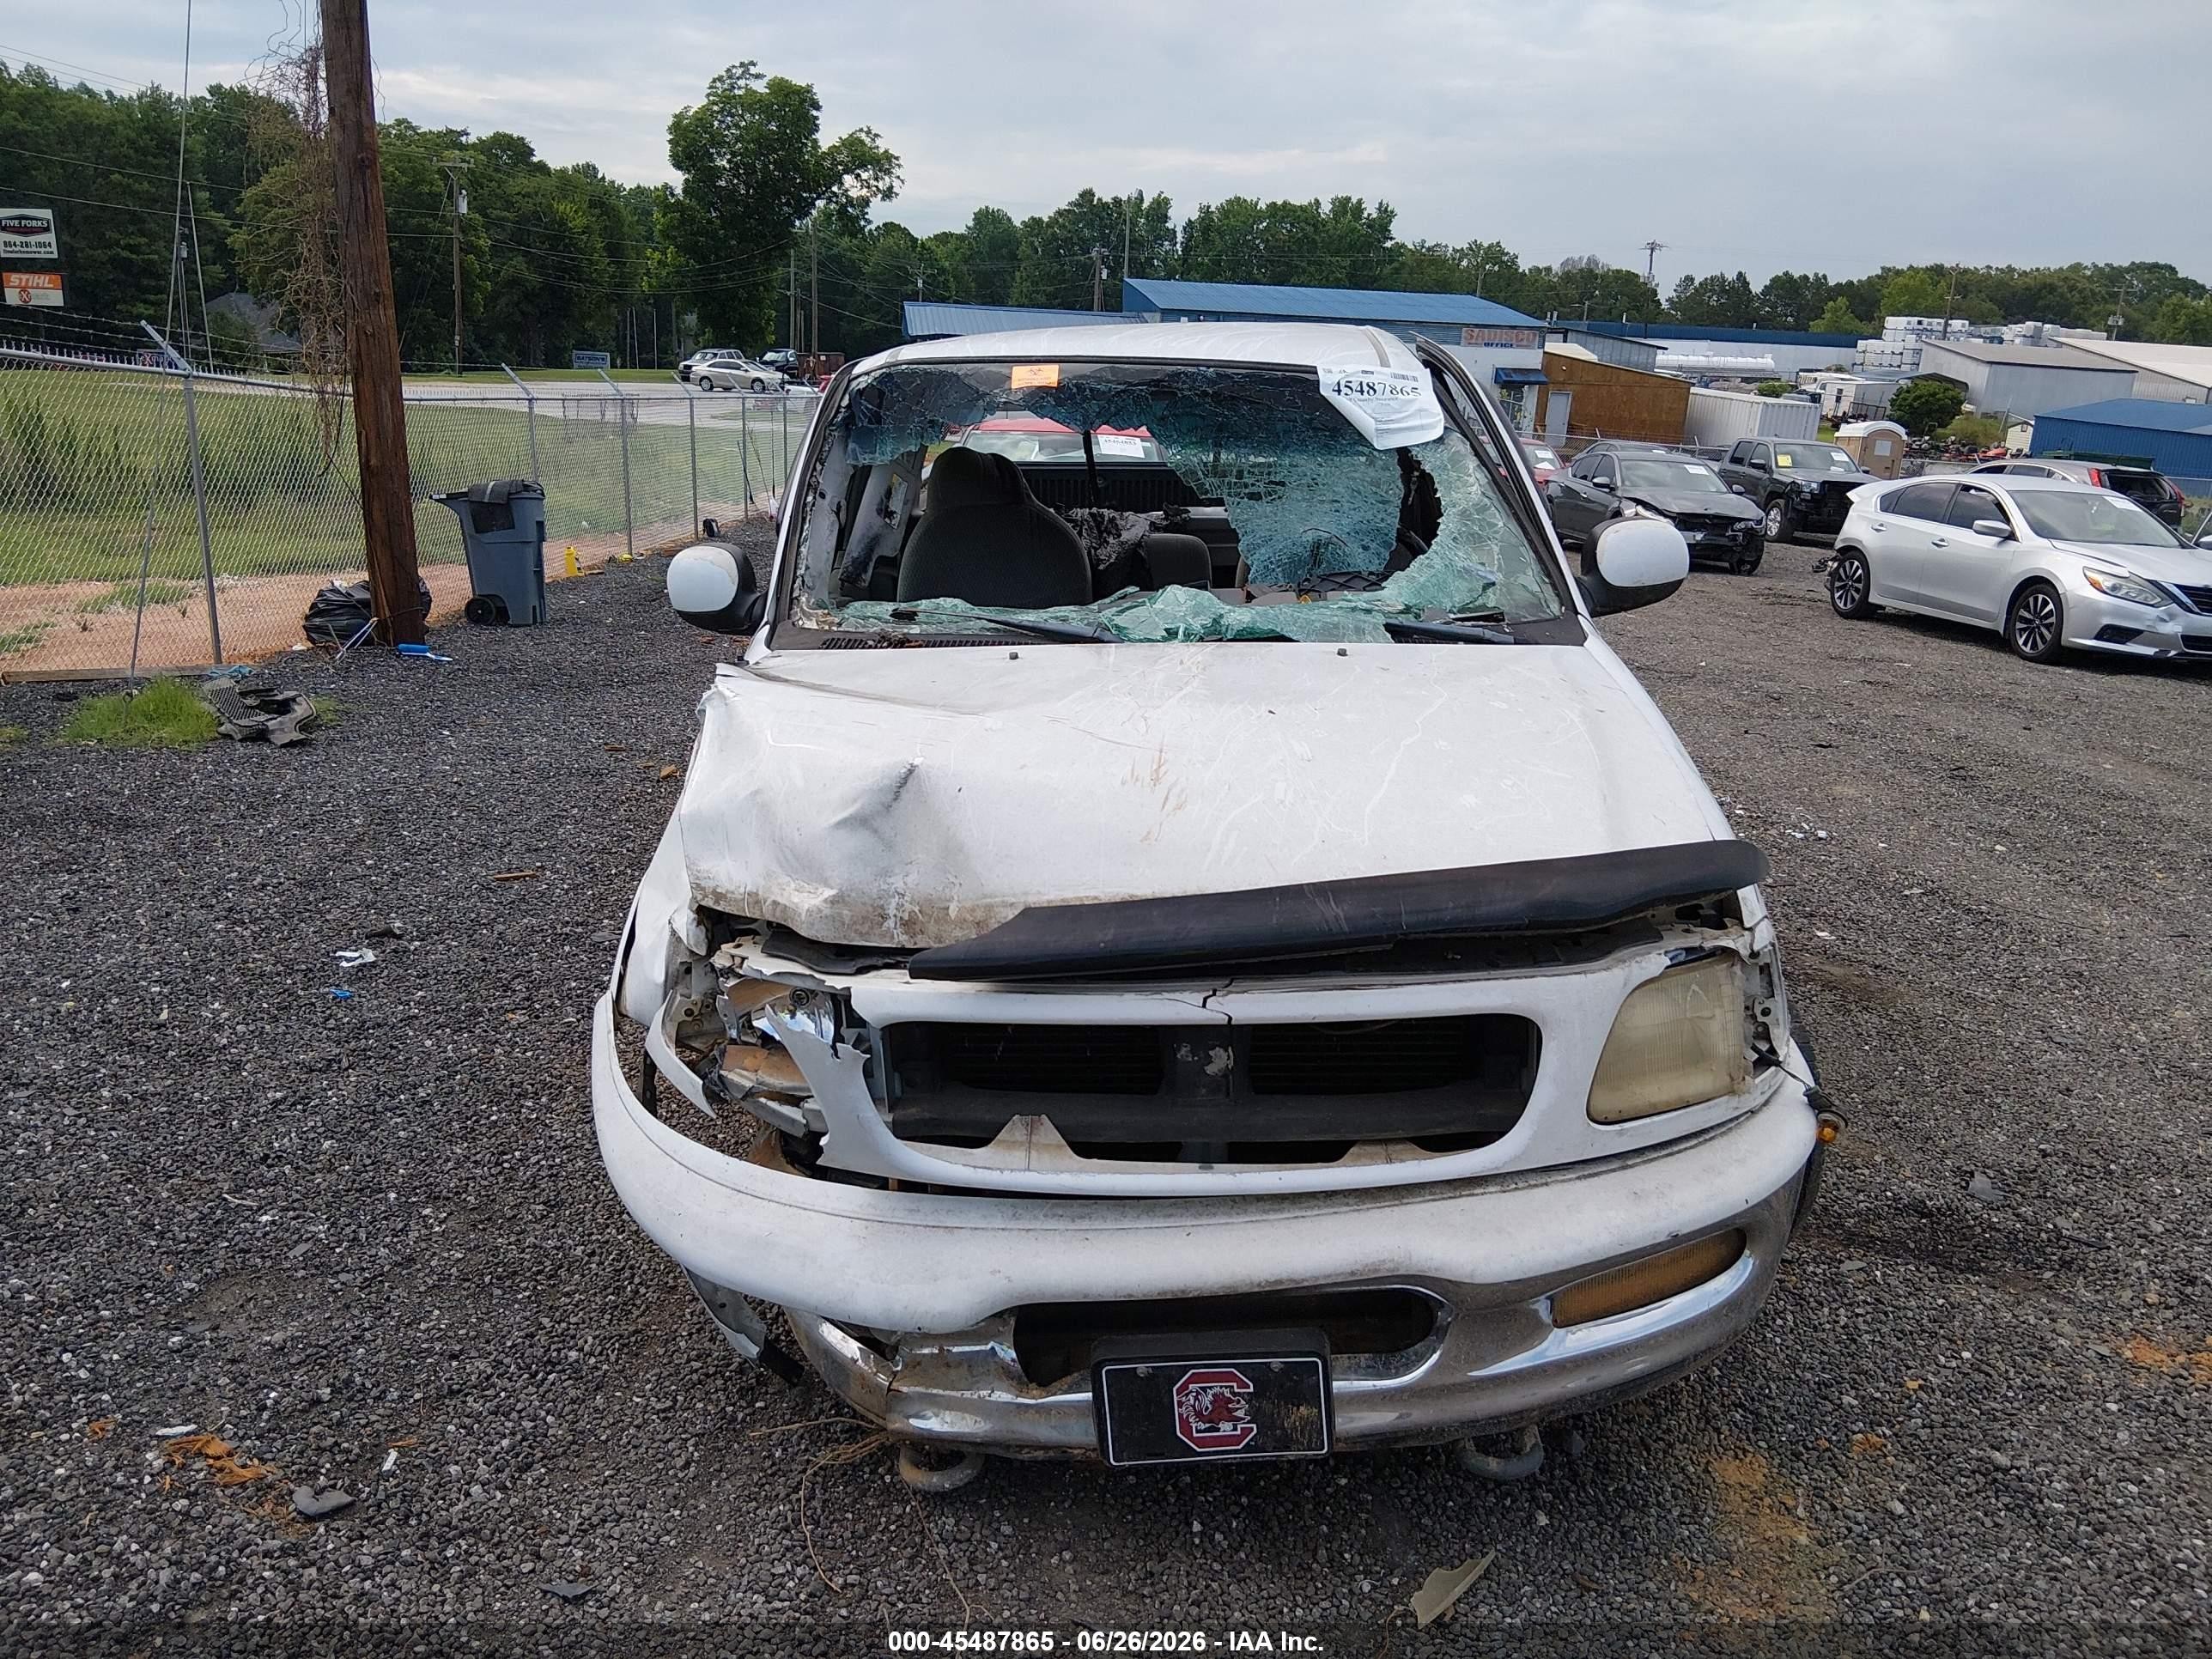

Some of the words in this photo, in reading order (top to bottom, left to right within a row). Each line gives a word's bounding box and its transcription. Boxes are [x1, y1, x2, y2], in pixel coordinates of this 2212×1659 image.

[3, 240, 52, 249] 864-281-1064
[9, 275, 54, 288] STIHL
[1464, 329, 1537, 343] SADISCO
[1332, 380, 1422, 397] 45487865
